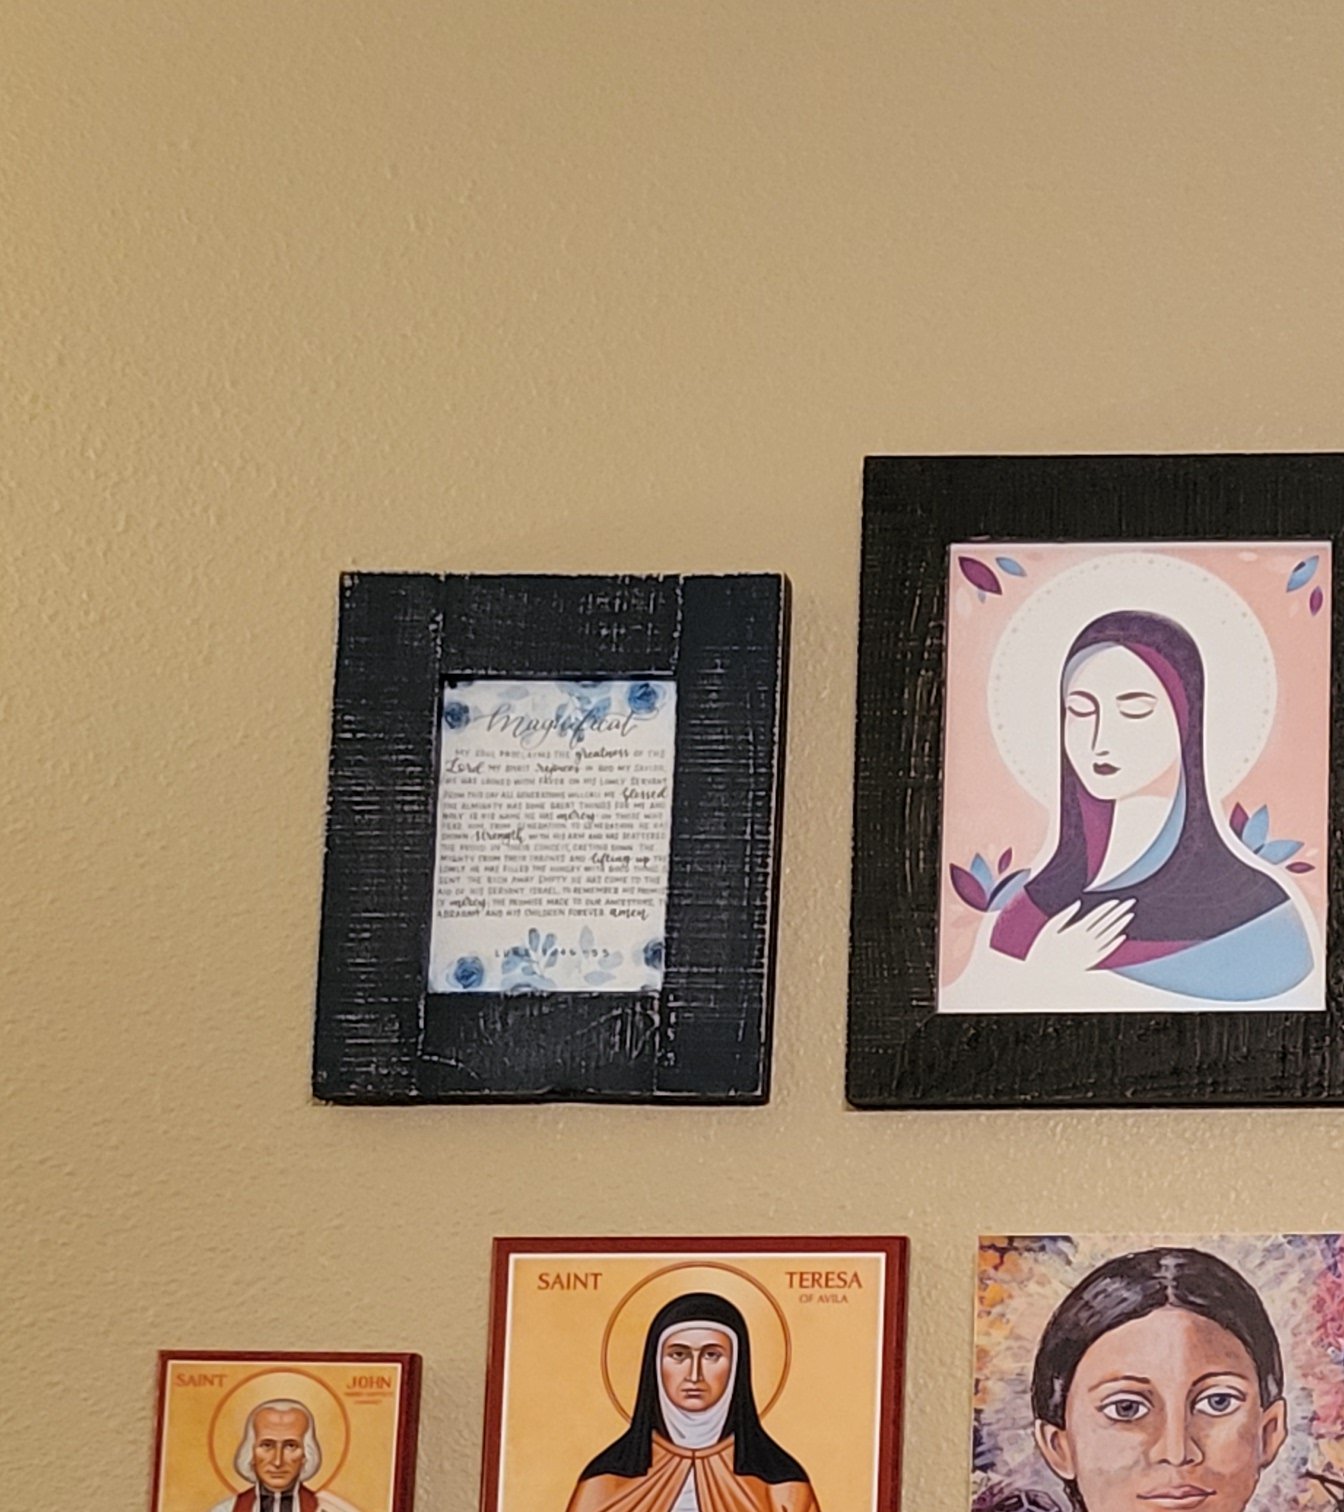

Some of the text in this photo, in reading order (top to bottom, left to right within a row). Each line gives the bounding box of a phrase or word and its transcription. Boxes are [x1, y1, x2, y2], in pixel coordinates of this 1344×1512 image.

[481, 703, 641, 749] Magnificat
[575, 747, 629, 765] greatness
[445, 757, 485, 775] Lord
[622, 786, 668, 803] blessed
[591, 852, 631, 867] lifting
[636, 855, 650, 869] up
[609, 907, 649, 921] amen
[537, 1271, 863, 1291] SAINT TERESA
[799, 1294, 849, 1304] OF AVILA
[174, 1372, 392, 1390] SAINT JOHN
